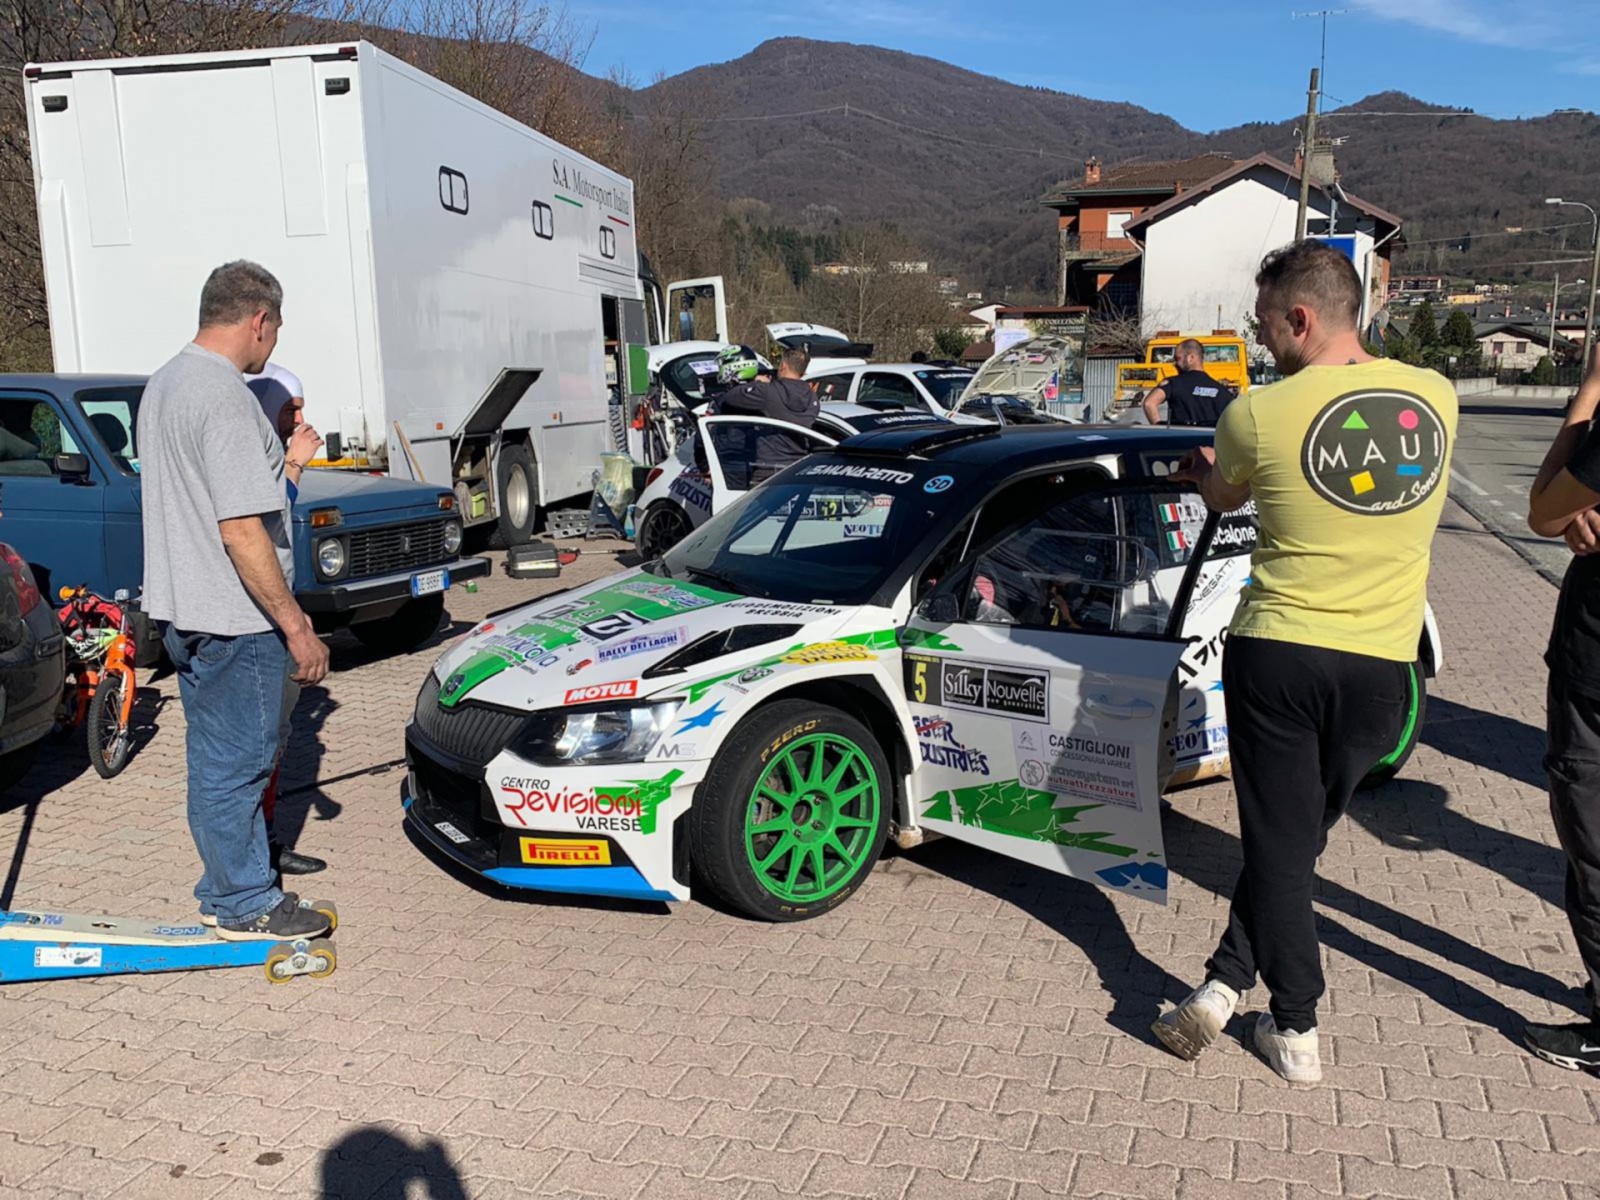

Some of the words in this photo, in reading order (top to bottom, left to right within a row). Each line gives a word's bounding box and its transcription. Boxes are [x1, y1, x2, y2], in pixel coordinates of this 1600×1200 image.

[572, 168, 613, 211] Motorsport
[613, 187, 629, 215] Italia
[1317, 430, 1440, 472] MAUI
[927, 477, 951, 491] SD
[1370, 491, 1406, 512] and
[1410, 470, 1439, 500] Sons
[1187, 557, 1236, 614] ENEGATTI
[721, 602, 842, 616] AUTODEMOLIZIONI
[745, 608, 803, 618] BREBBIA
[599, 643, 628, 659] RALLY
[629, 639, 648, 652] DEI
[648, 631, 678, 650] LAGHI
[567, 681, 634, 700] MOTUL
[914, 661, 928, 703] 5
[944, 671, 983, 705] Silky
[986, 679, 1046, 705] Nouvelle
[770, 719, 818, 748] ZERO
[656, 742, 697, 759] MS
[1048, 734, 1131, 759] CASTIGLIONI
[1049, 748, 1107, 766] CONCESSIONARIA
[1106, 756, 1132, 770] VARESE
[500, 776, 551, 791] CENTRO
[1047, 775, 1136, 799] autoattrezzature
[501, 786, 642, 826] Revisioni
[576, 816, 642, 832] VARESE
[527, 843, 600, 861] PIRELLI
